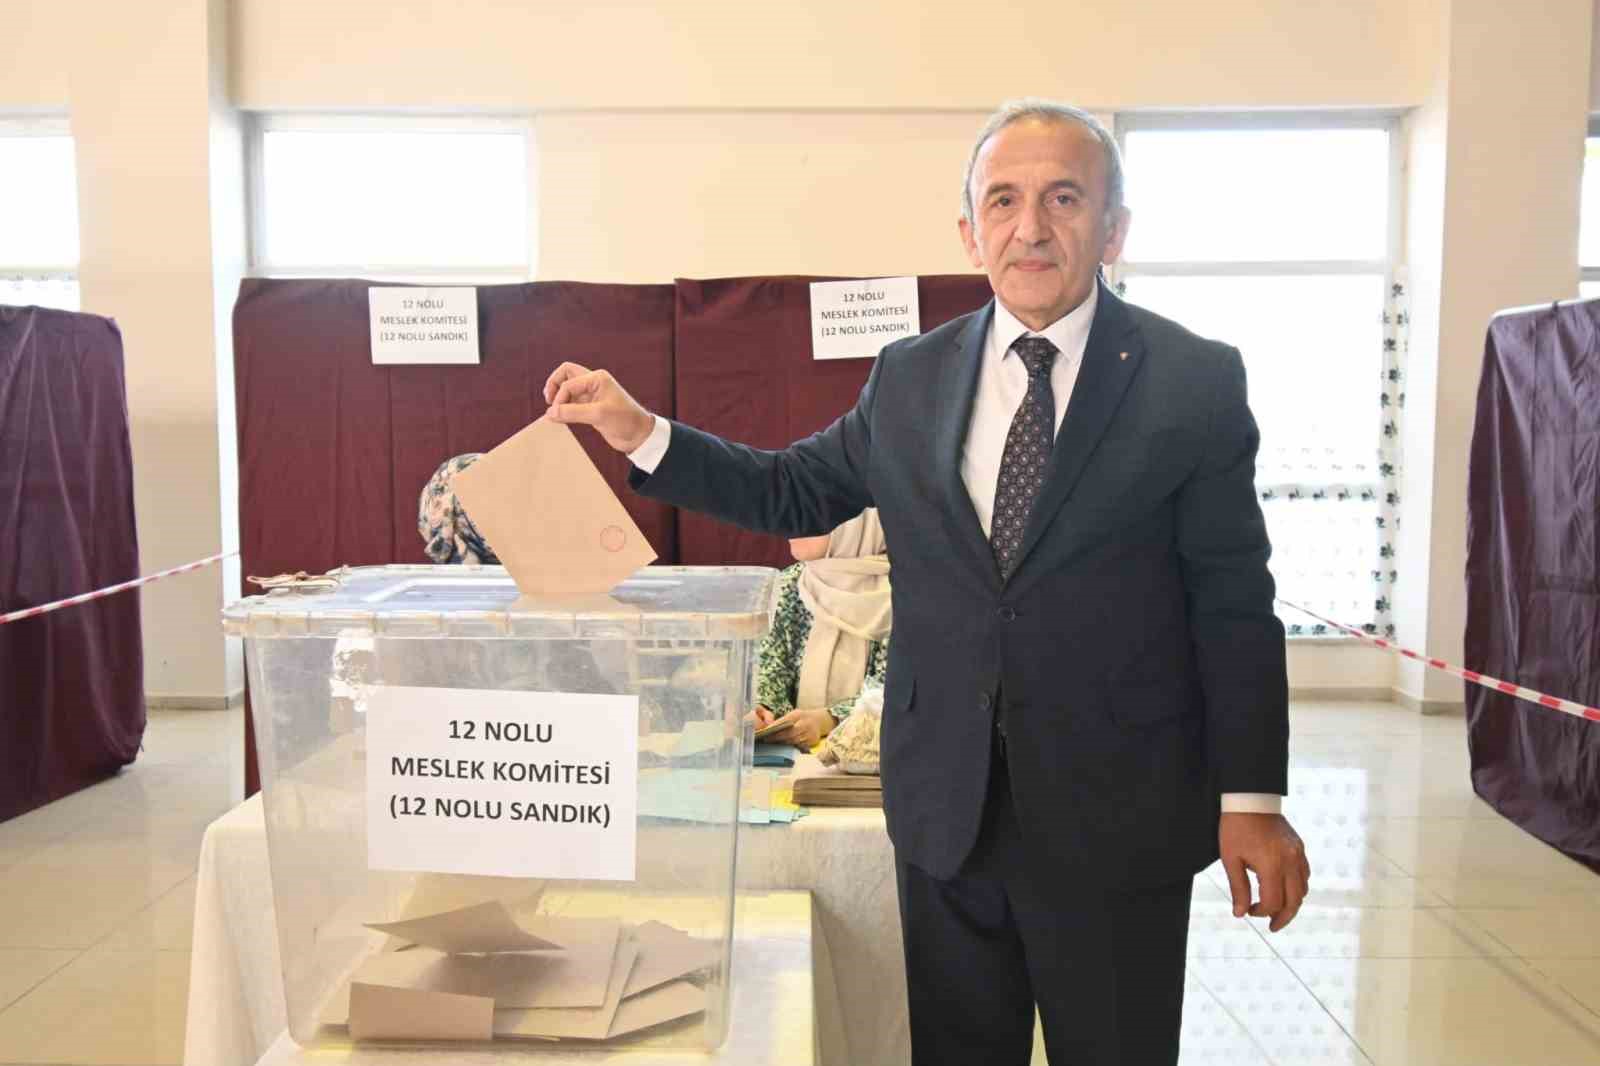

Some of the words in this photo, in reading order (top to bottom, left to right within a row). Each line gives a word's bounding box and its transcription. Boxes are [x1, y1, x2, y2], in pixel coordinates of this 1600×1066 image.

[402, 299, 414, 309] 12
[416, 299, 444, 309] NOLU
[843, 293, 855, 303] 12
[857, 292, 885, 302] NOLU
[821, 309, 859, 320] MESLEK
[821, 327, 837, 337] (12
[839, 326, 866, 336] NOLU
[869, 323, 910, 334] SANDIK)
[448, 720, 476, 740] 12
[484, 721, 553, 743] NOLU
[391, 756, 485, 780] MESLEK
[493, 760, 611, 785] KOMİTESİ
[390, 794, 427, 820] (12
[435, 797, 502, 820] NOLU
[510, 801, 611, 828] SANDIK)
